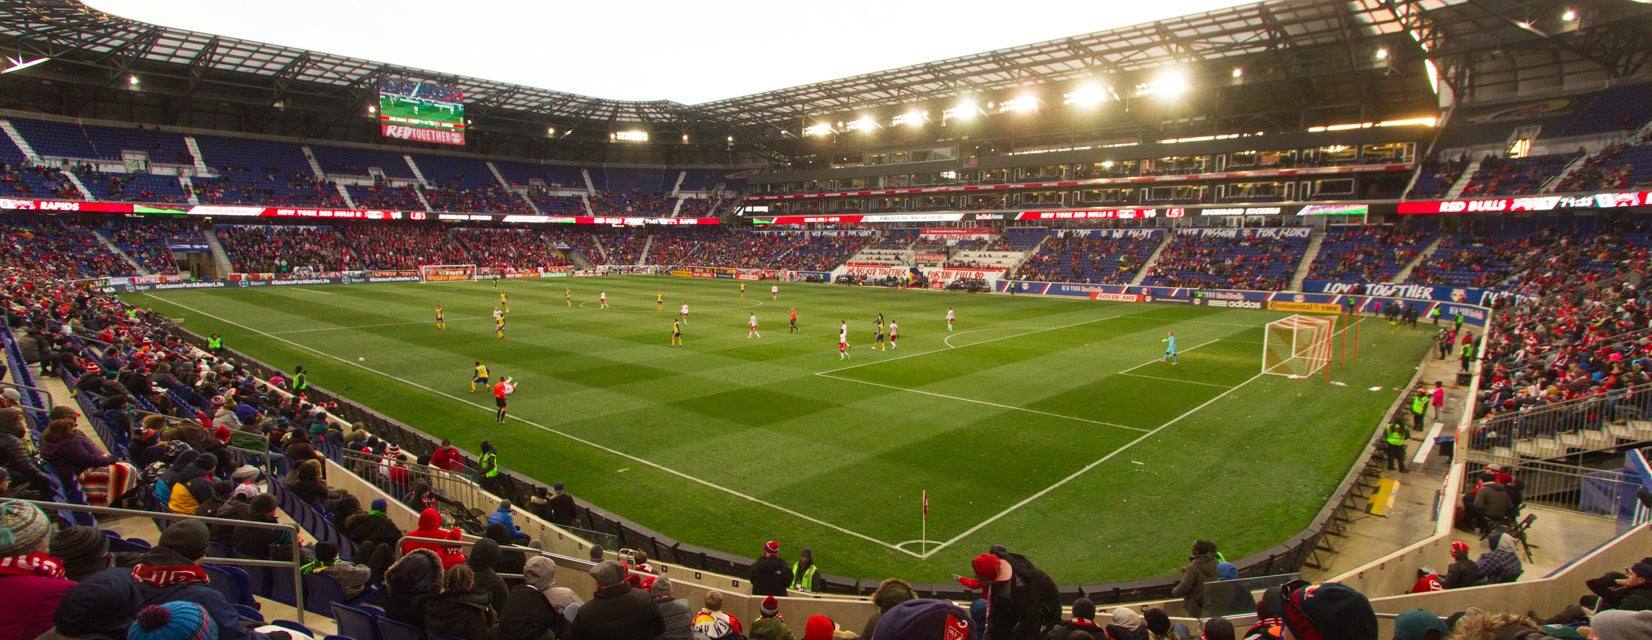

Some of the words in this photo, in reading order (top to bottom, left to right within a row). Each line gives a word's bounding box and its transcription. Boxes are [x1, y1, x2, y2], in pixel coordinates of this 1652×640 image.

[40, 201, 80, 211] RAPIDS
[1439, 201, 1466, 212] RED
[1468, 200, 1507, 212] BULLS
[1144, 209, 1156, 218] VS
[1201, 208, 1244, 216] RICHMOND
[1245, 207, 1281, 215] KICKERS
[1112, 229, 1126, 239] WE
[1200, 228, 1239, 239] PASSION
[1255, 228, 1278, 239] FOR
[879, 269, 907, 277] TOGETHER
[927, 270, 941, 279] FOR
[954, 271, 973, 280] FULL
[1365, 283, 1434, 300] TOGETHER
[1228, 301, 1262, 309] adidas
[1270, 301, 1314, 312] Continental
